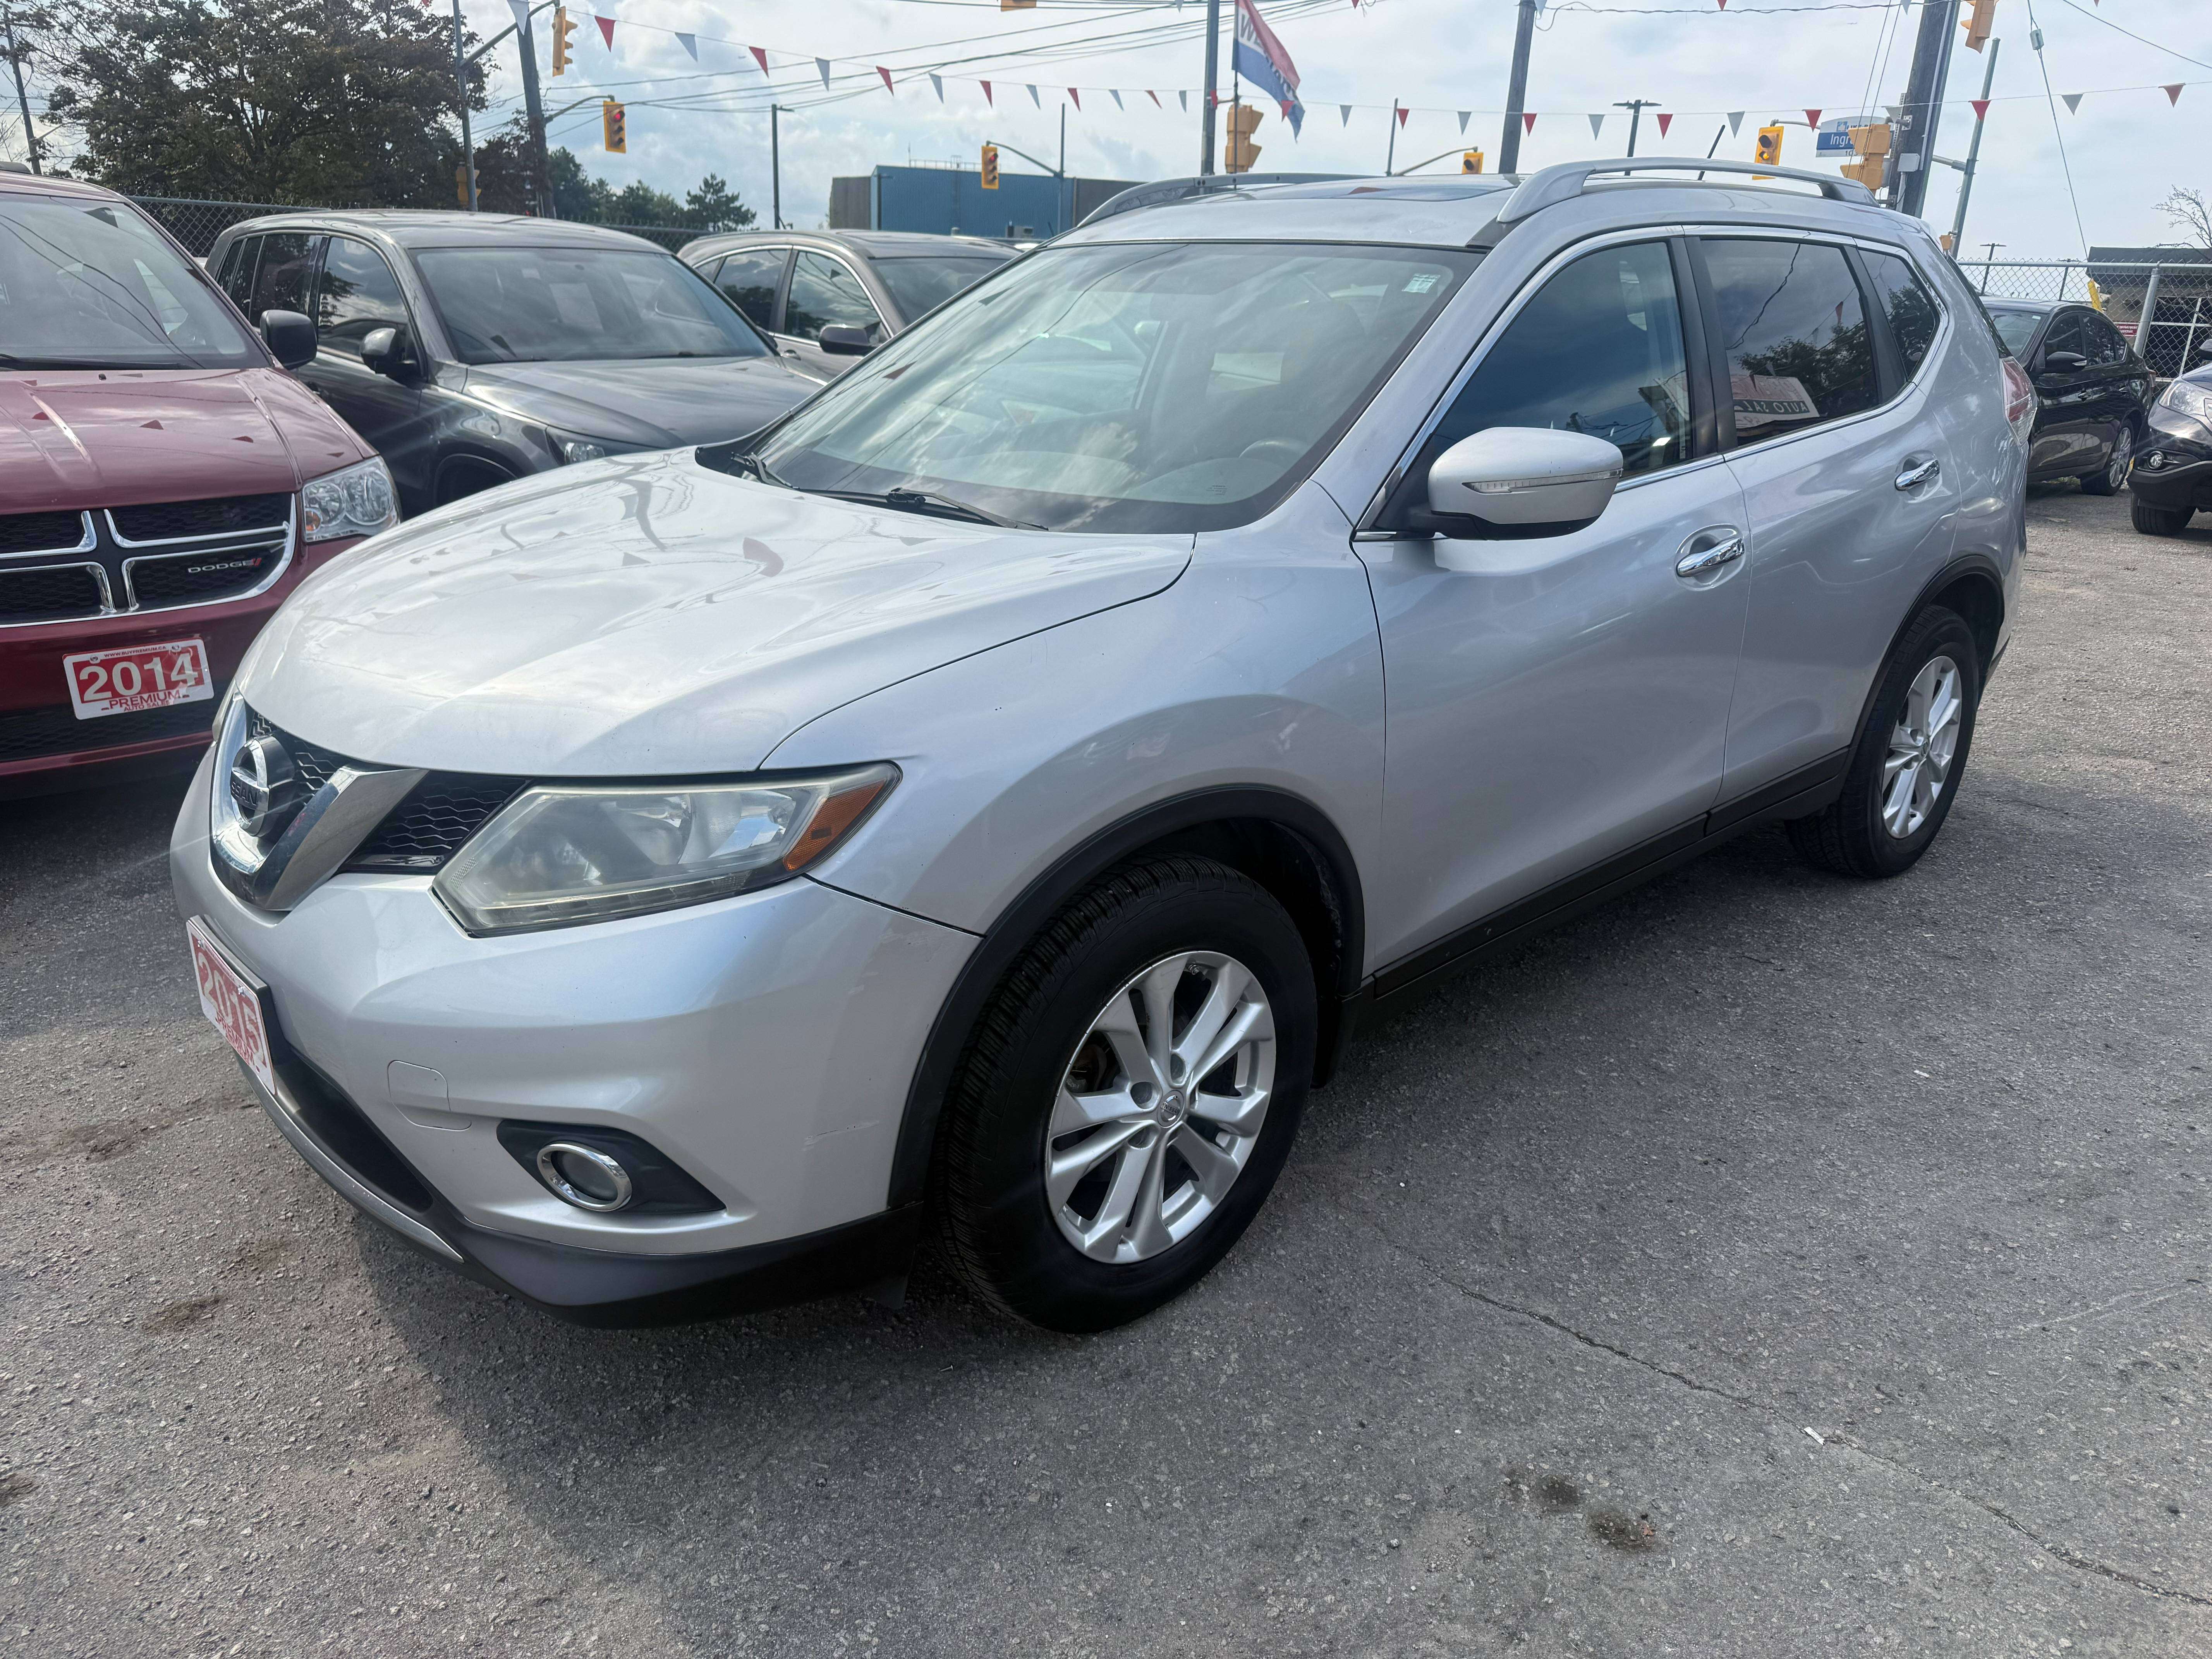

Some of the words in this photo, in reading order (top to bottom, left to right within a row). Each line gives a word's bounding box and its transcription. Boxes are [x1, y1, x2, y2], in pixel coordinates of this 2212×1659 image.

[188, 558, 256, 573] DODGE
[103, 645, 167, 658] WWW.BUYPREMIUM.CA
[79, 653, 199, 702] 2014
[108, 690, 181, 709] PREMIUM
[198, 952, 264, 1063] 2015
